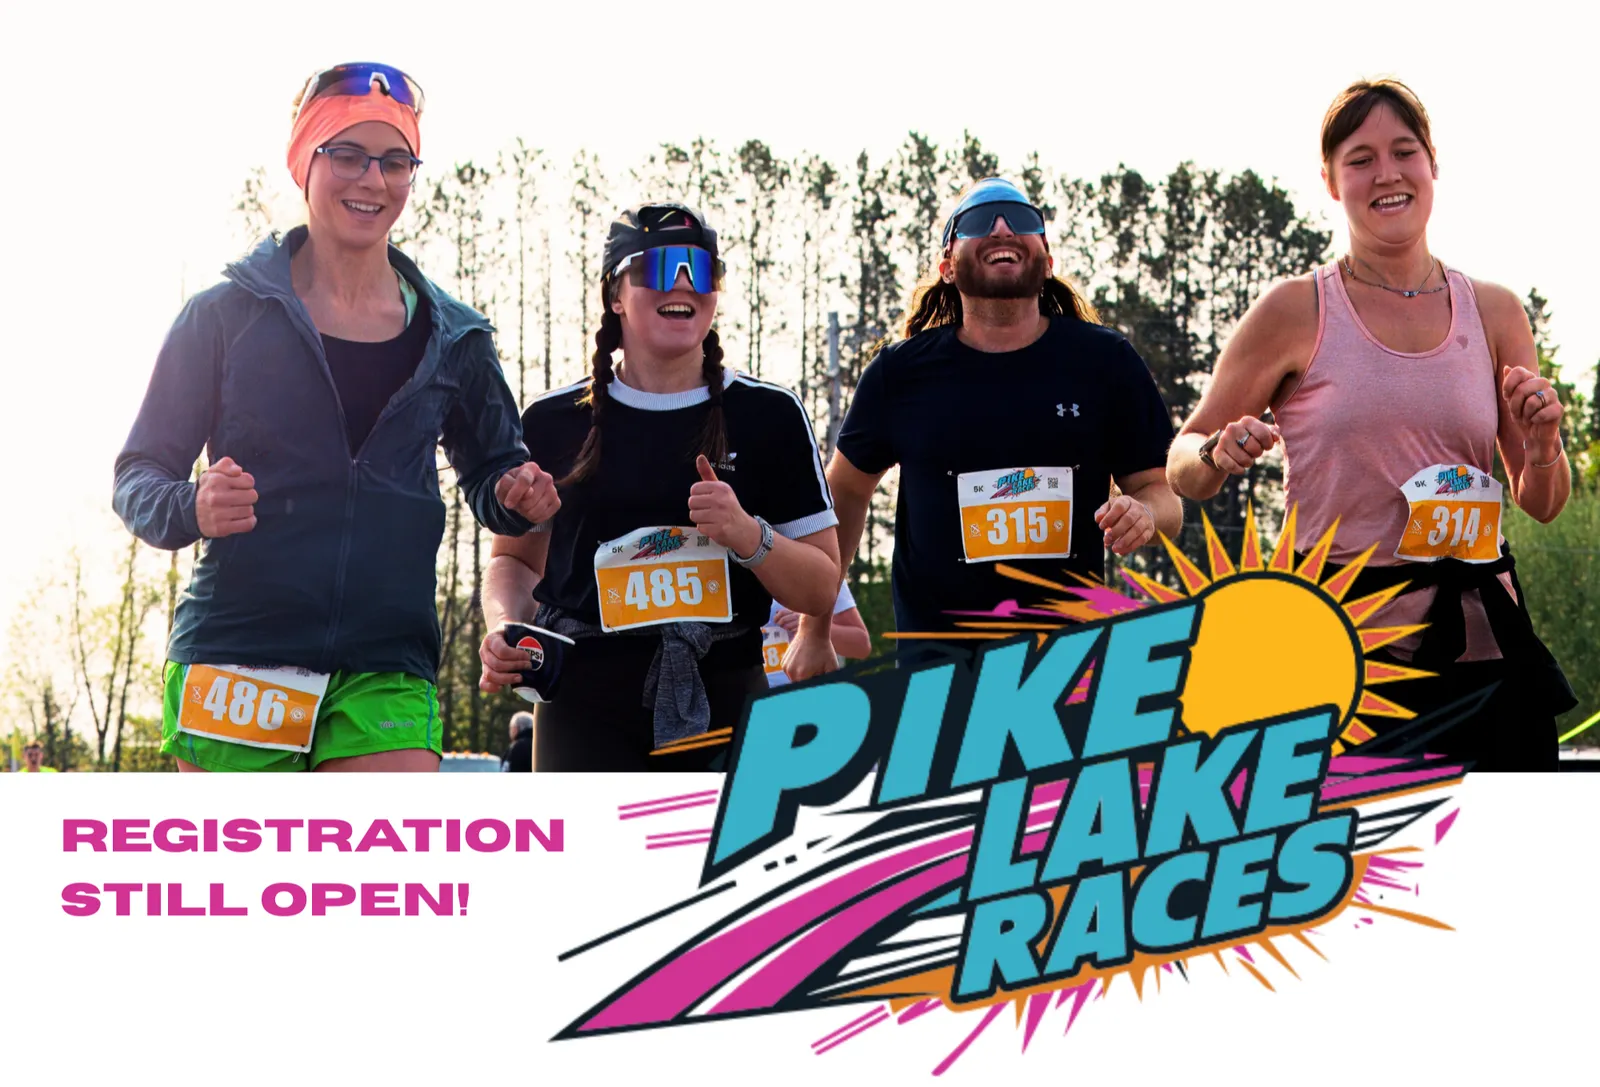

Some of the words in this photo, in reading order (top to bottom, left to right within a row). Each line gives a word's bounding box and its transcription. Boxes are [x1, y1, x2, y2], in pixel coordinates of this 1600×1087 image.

[997, 471, 1025, 489] PIKE
[1414, 480, 1427, 488] 5K
[1438, 468, 1458, 485] PIKE
[974, 485, 984, 493] 5K
[986, 506, 1048, 545] 315
[1427, 506, 1480, 547] 314
[612, 545, 623, 553] 5K
[639, 529, 671, 550] PIKE
[624, 566, 703, 610] 485
[203, 675, 288, 730] 486
